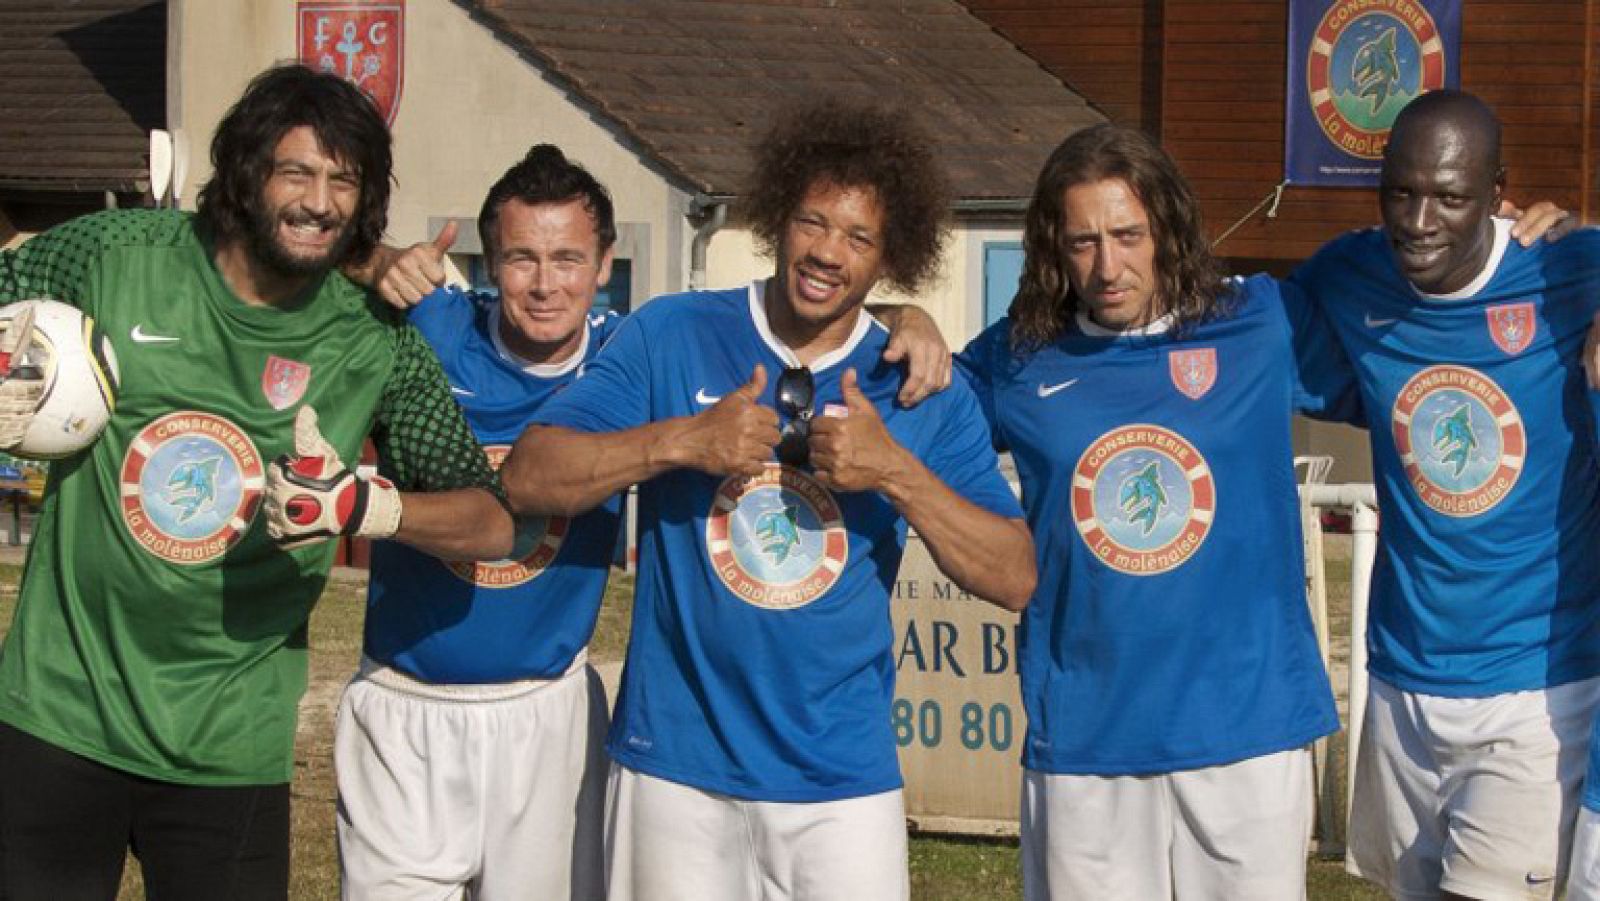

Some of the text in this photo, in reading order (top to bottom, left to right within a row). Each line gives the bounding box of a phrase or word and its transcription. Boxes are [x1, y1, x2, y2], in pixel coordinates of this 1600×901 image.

[1324, 112, 1340, 135] la
[1406, 371, 1501, 406] CONSERVERIE
[156, 418, 255, 468] CONSERVERIE
[1088, 431, 1190, 468] CONSERVERIE
[128, 508, 142, 527] la
[1094, 531, 1199, 571] la molénaise
[721, 561, 737, 581] la
[896, 619, 966, 678] AR
[892, 699, 1013, 751] 80 80
